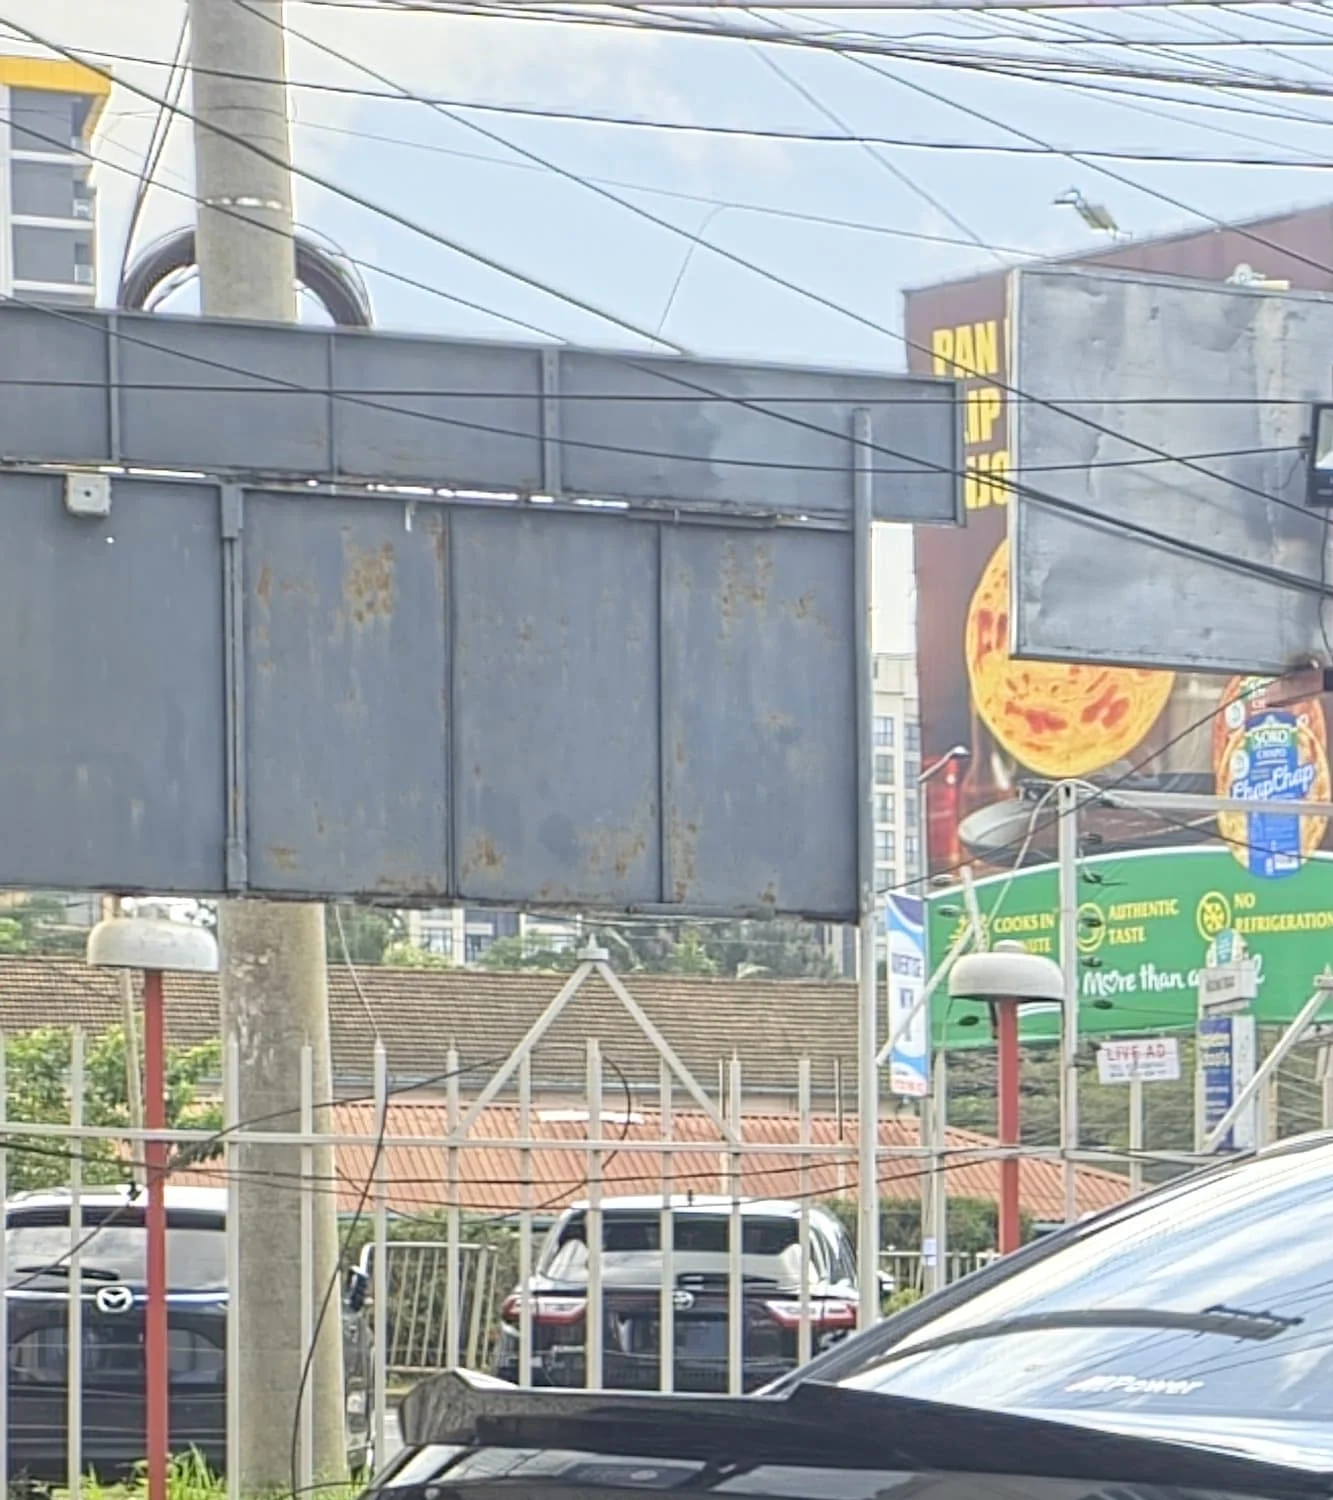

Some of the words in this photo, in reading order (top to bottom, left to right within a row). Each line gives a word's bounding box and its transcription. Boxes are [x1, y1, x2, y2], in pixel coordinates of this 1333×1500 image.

[932, 320, 998, 379] PAN
[964, 387, 1001, 444] IP
[1108, 899, 1180, 921] AUTHENTIC
[1233, 892, 1256, 909] NO
[993, 914, 1040, 934] COOKS
[1040, 913, 1056, 930] IN
[1108, 926, 1147, 945] TASTE
[1083, 970, 1137, 997] More
[1140, 963, 1182, 993] than
